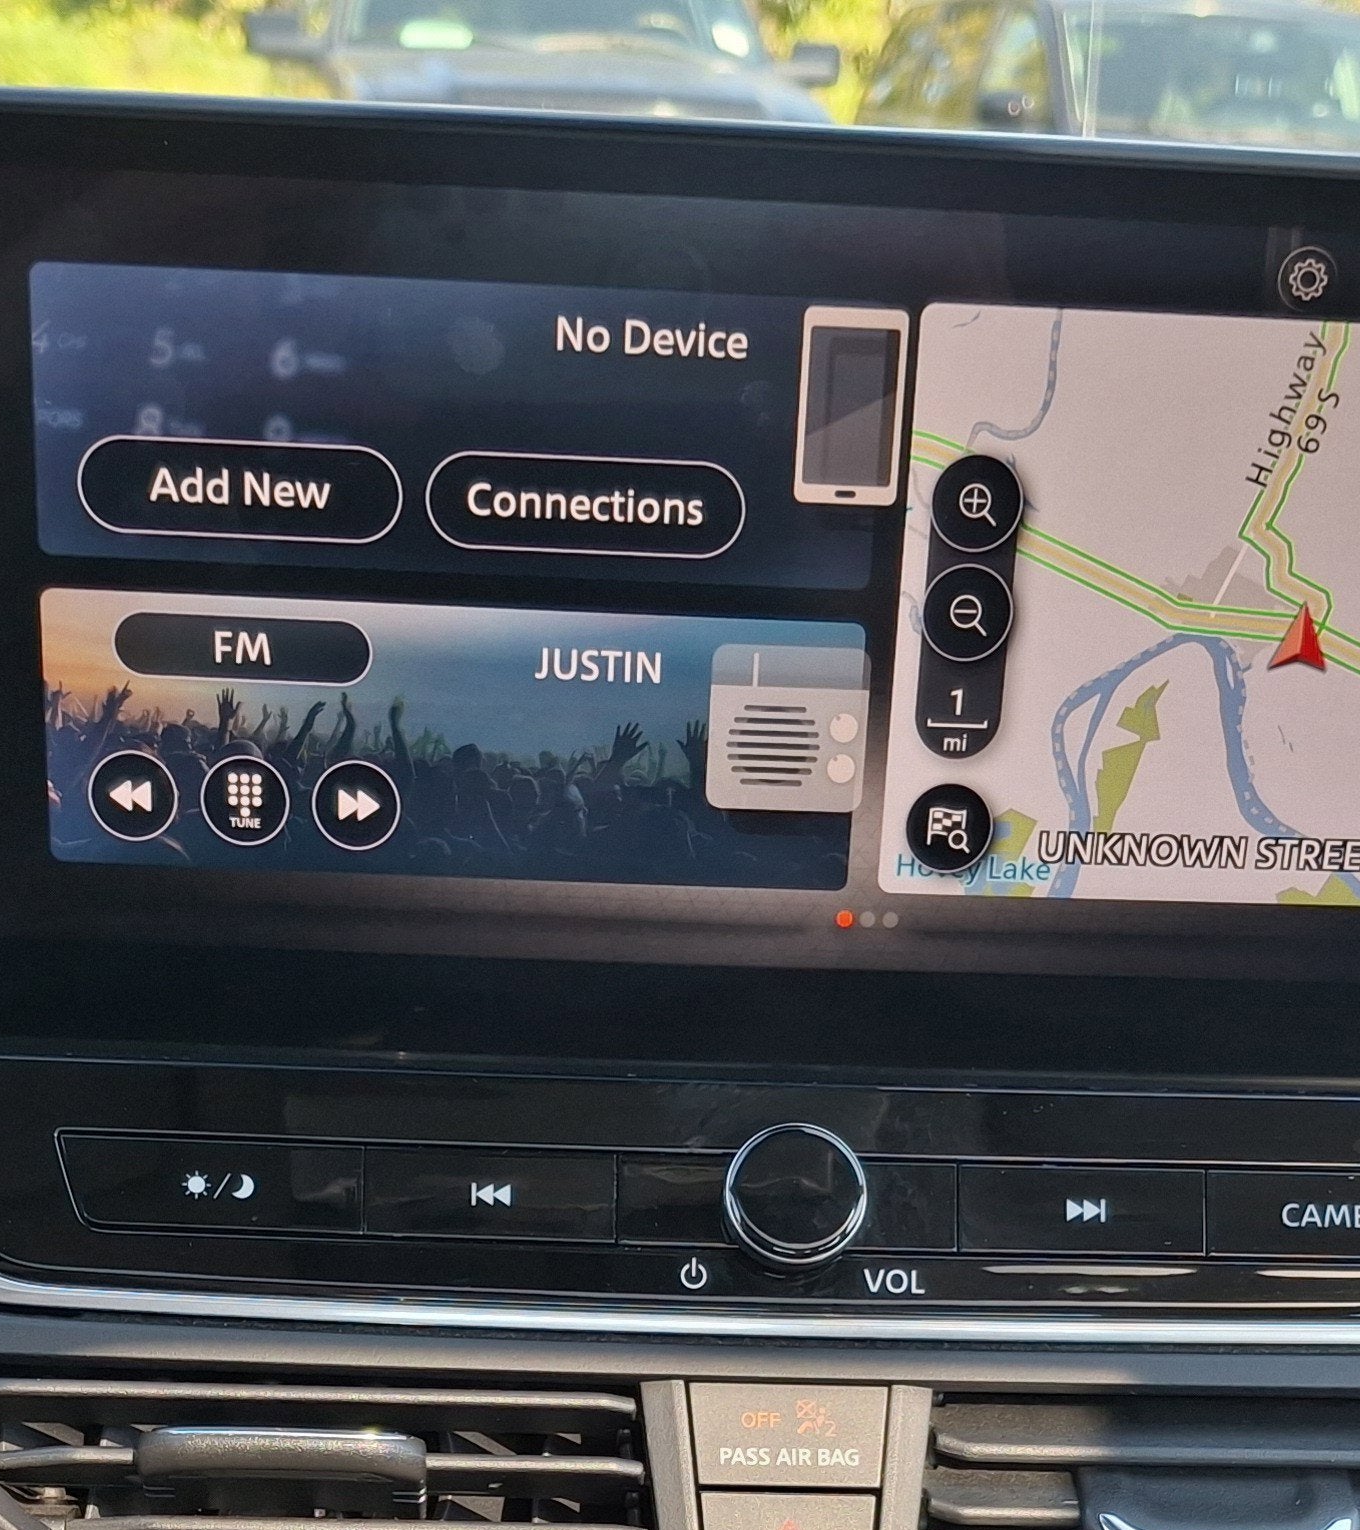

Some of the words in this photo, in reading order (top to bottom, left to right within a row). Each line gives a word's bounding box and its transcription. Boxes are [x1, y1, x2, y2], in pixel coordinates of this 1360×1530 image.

[556, 315, 611, 353] No
[624, 318, 749, 359] Device
[1244, 331, 1327, 488] Highway
[1297, 412, 1329, 454] 69
[1317, 390, 1341, 410] S
[150, 466, 229, 506] Add
[243, 471, 332, 509] New
[467, 482, 705, 526] Connections
[213, 630, 274, 665] FM
[535, 647, 662, 684] JUSTIN
[950, 688, 964, 716] 1
[943, 733, 969, 752] mi
[229, 817, 262, 830] TUNE
[1040, 830, 1247, 869] UNKNOWN
[988, 855, 1051, 881] Lake
[863, 1268, 926, 1294] VOL
[740, 1411, 782, 1429] OFF
[720, 1447, 770, 1466] PASS
[776, 1448, 811, 1466] AIR
[817, 1448, 859, 1467] BAG
